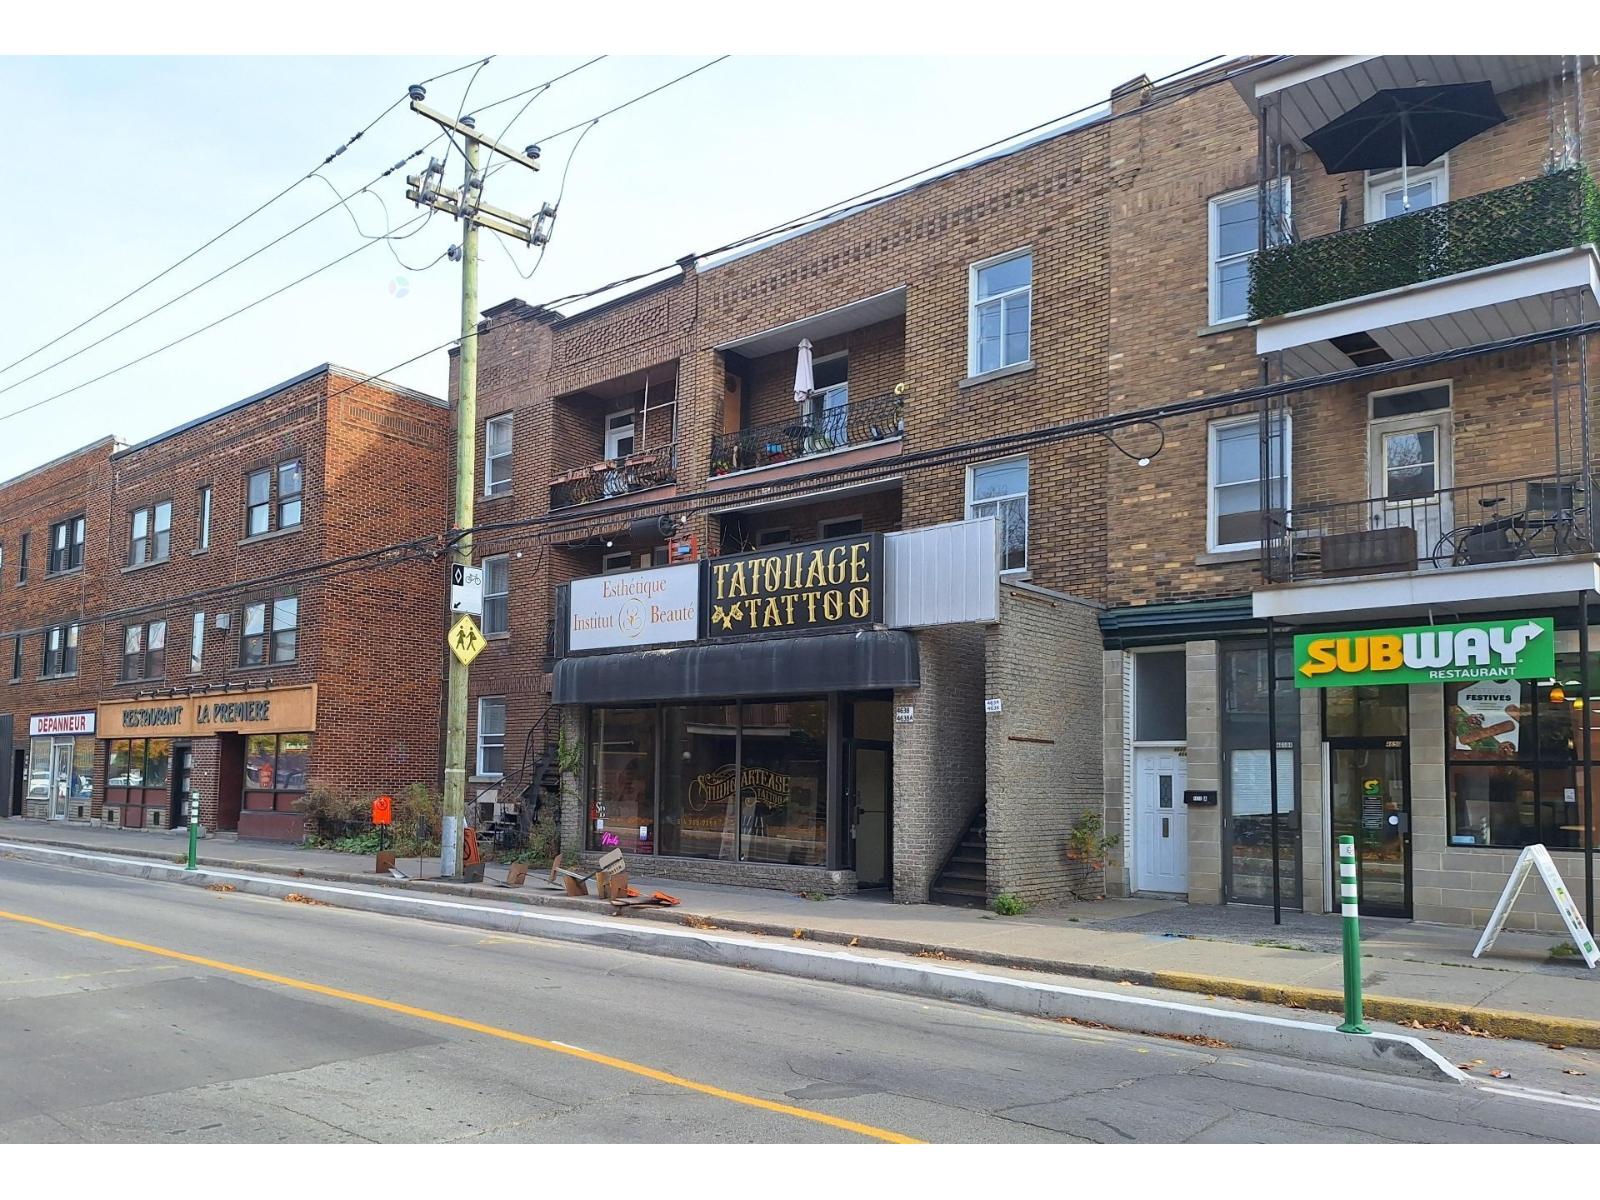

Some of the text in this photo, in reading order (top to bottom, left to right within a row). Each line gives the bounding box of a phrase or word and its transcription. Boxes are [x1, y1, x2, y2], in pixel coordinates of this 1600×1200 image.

[713, 541, 871, 600] TATOUAGE
[602, 576, 668, 599] Esthétique
[573, 603, 695, 632] Institut Beauté
[744, 586, 871, 629] TATTOO
[1299, 621, 1545, 678] SUBWAY
[1429, 667, 1517, 679] RESTAURANT
[1466, 694, 1512, 702] FESTIVES
[122, 705, 184, 727] RESTAURANT
[197, 704, 209, 724] LA
[740, 769, 791, 793] ARTEASE
